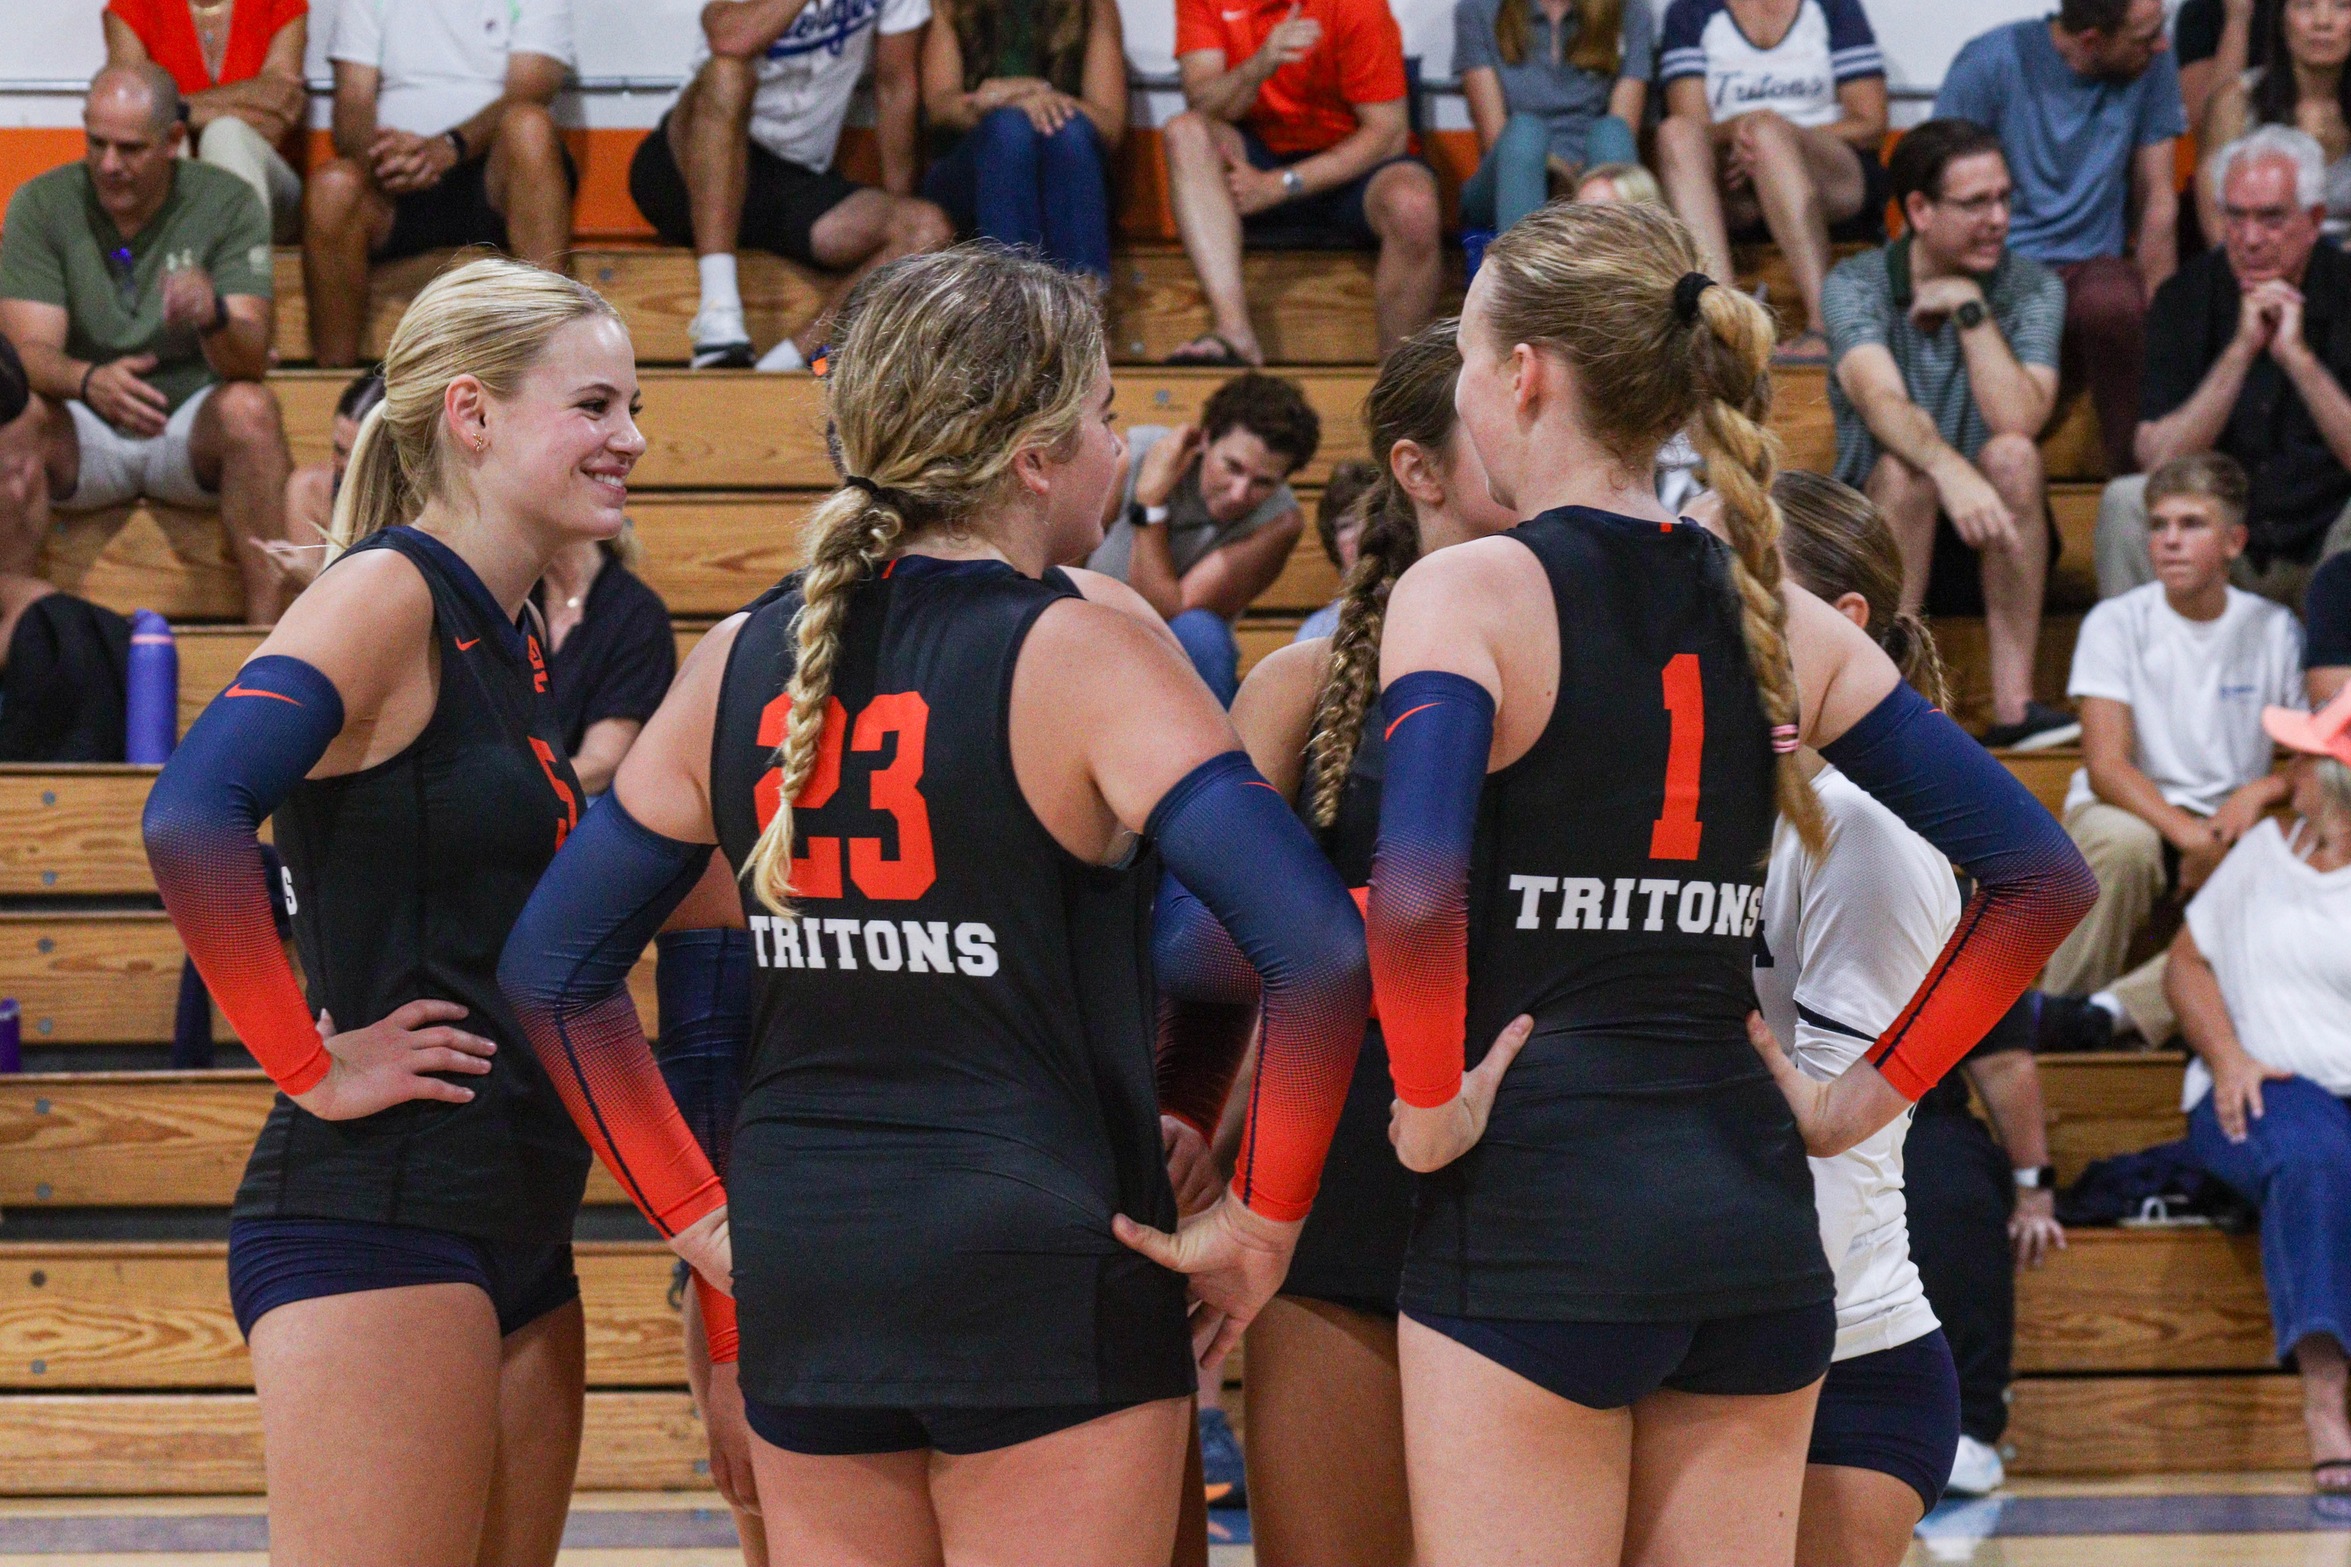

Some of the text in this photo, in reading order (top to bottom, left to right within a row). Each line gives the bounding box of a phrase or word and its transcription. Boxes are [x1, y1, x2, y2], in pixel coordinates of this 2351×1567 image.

[753, 690, 937, 901] 23
[1649, 653, 1705, 861] 1
[749, 915, 999, 978] TRITONS
[1508, 874, 1764, 938] TRITONS
